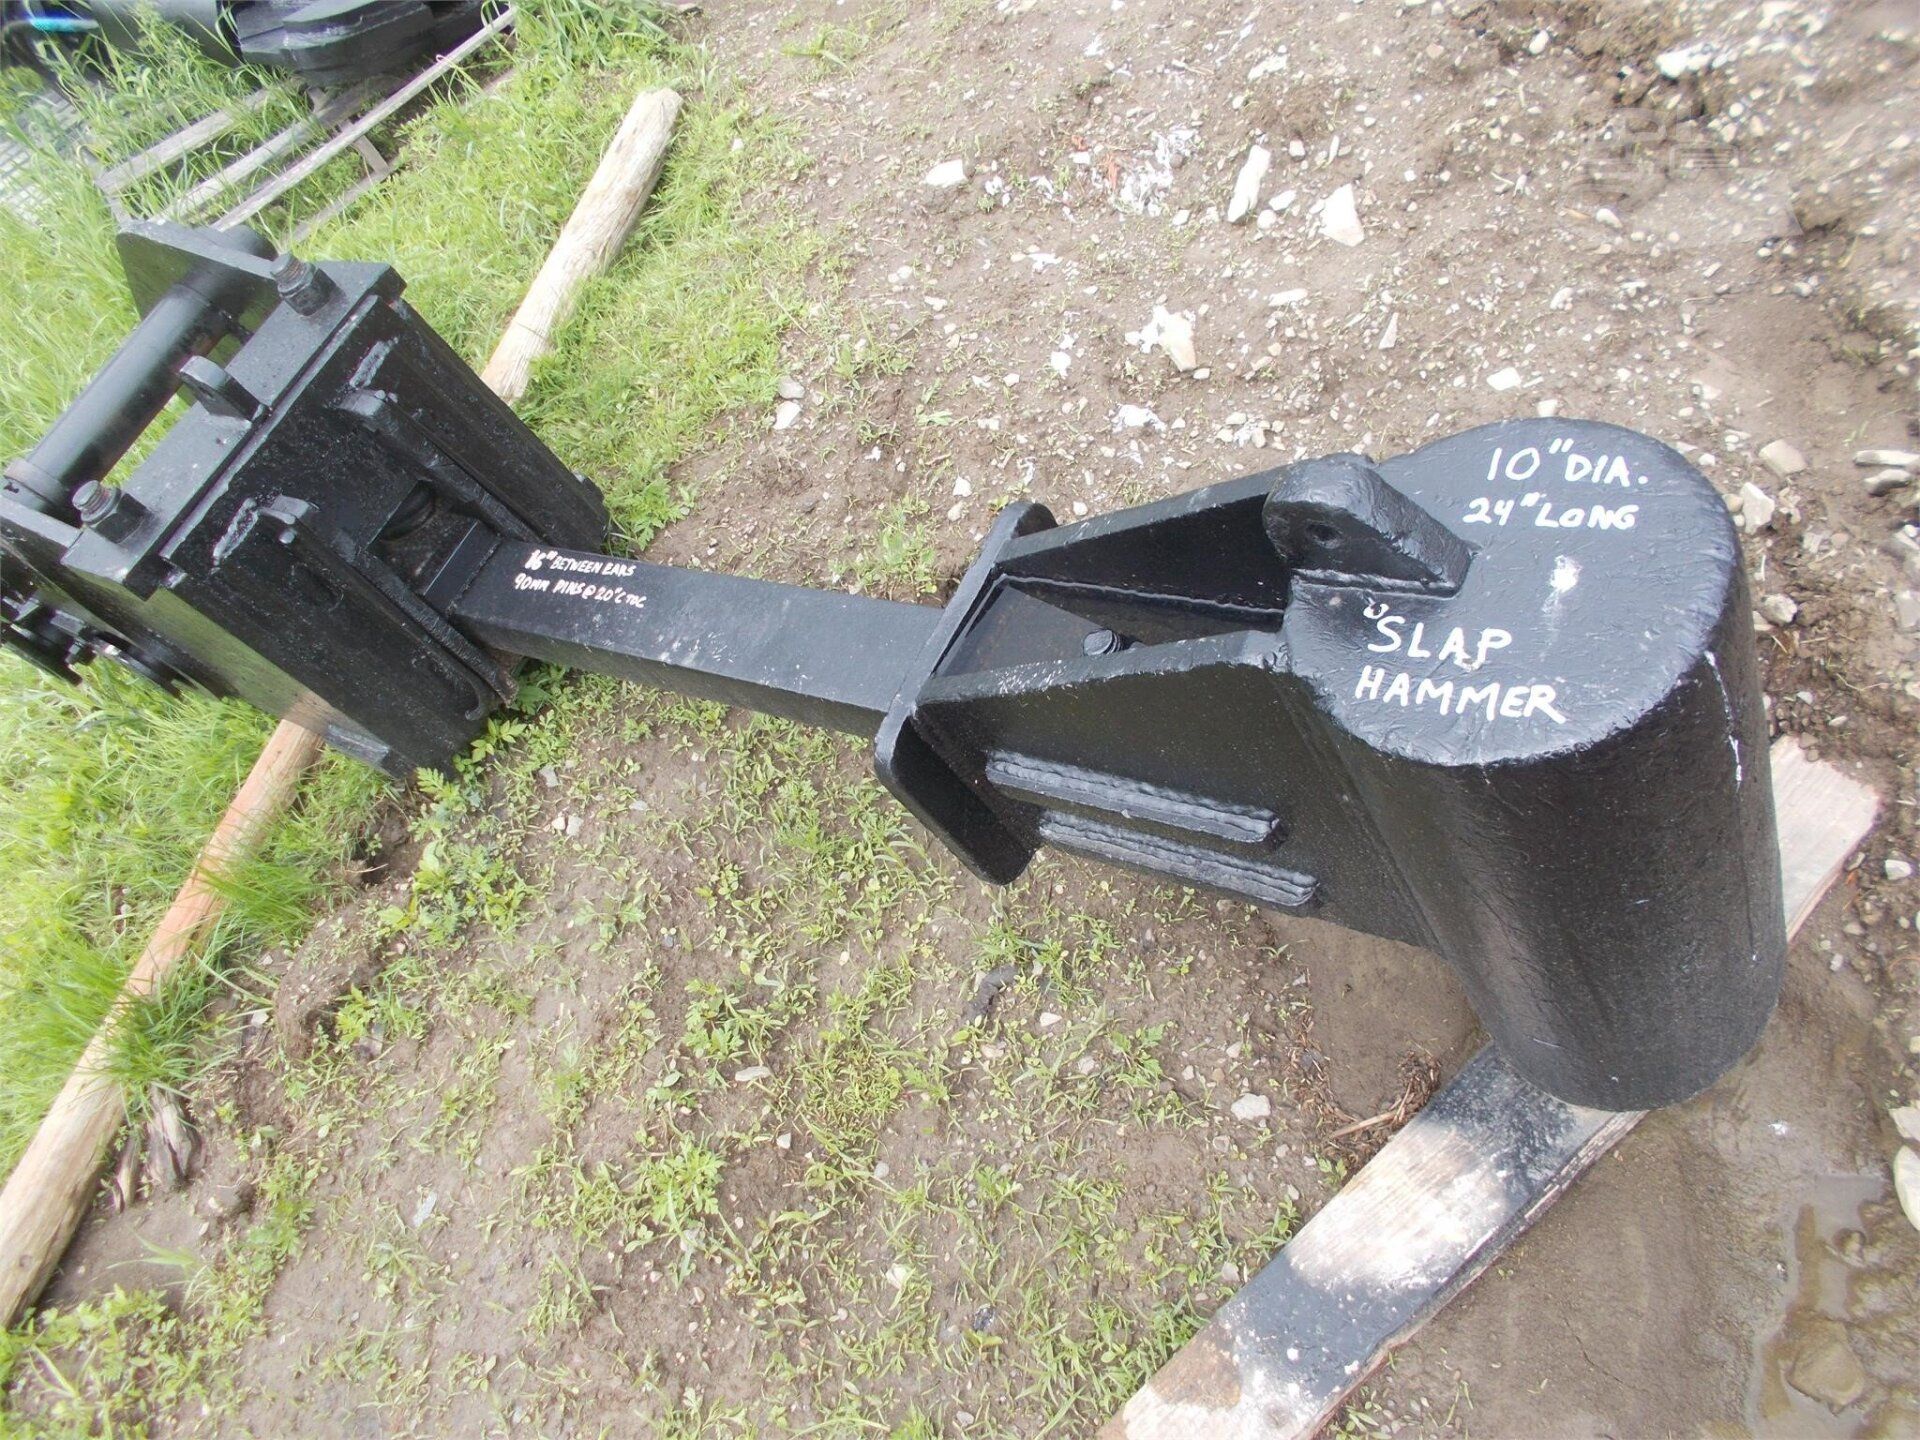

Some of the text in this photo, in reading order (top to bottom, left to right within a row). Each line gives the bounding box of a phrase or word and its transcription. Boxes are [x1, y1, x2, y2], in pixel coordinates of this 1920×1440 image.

[550, 555, 604, 574] BETWEEN
[602, 562, 637, 577] EARS
[1355, 664, 1567, 724] HAMMER
